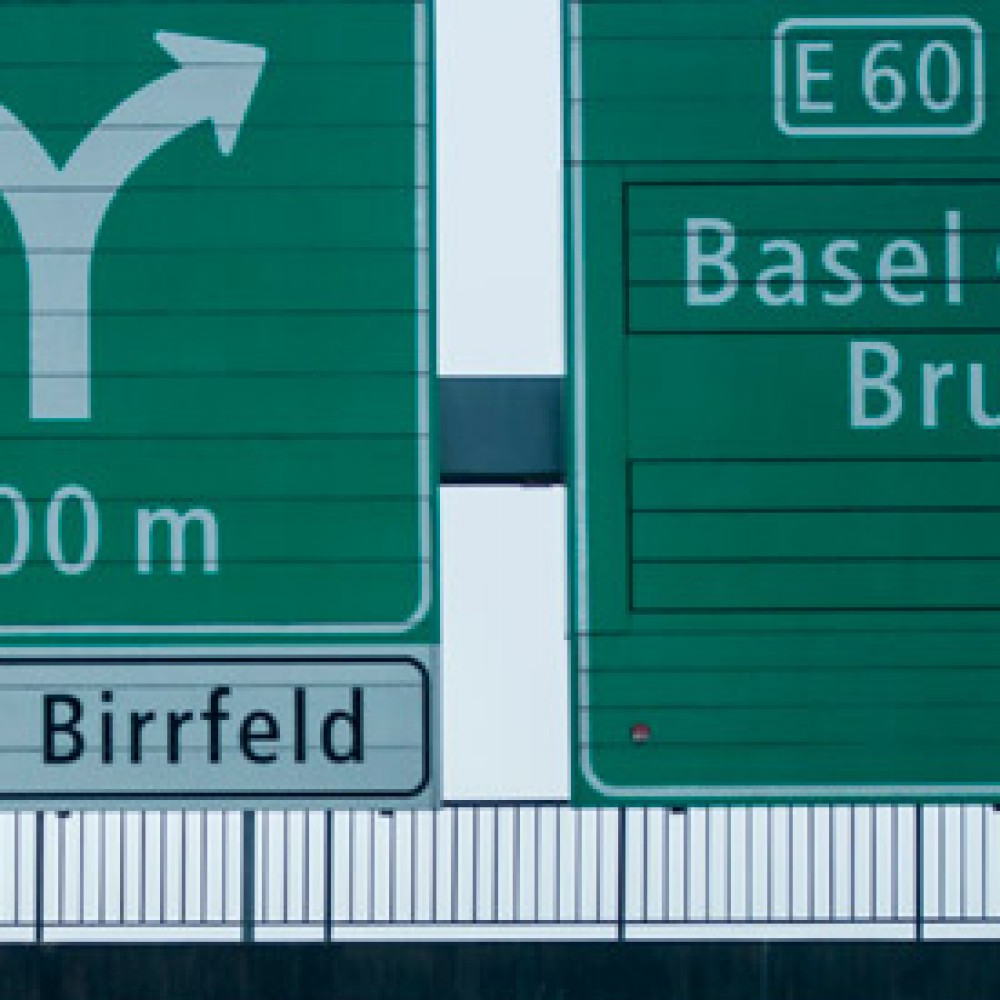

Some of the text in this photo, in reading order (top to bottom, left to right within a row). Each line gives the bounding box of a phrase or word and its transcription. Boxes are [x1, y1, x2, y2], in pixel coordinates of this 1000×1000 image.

[796, 40, 961, 112] E 60
[685, 210, 961, 305] Basel
[137, 507, 218, 574] m
[42, 687, 364, 765] Birrfeld
